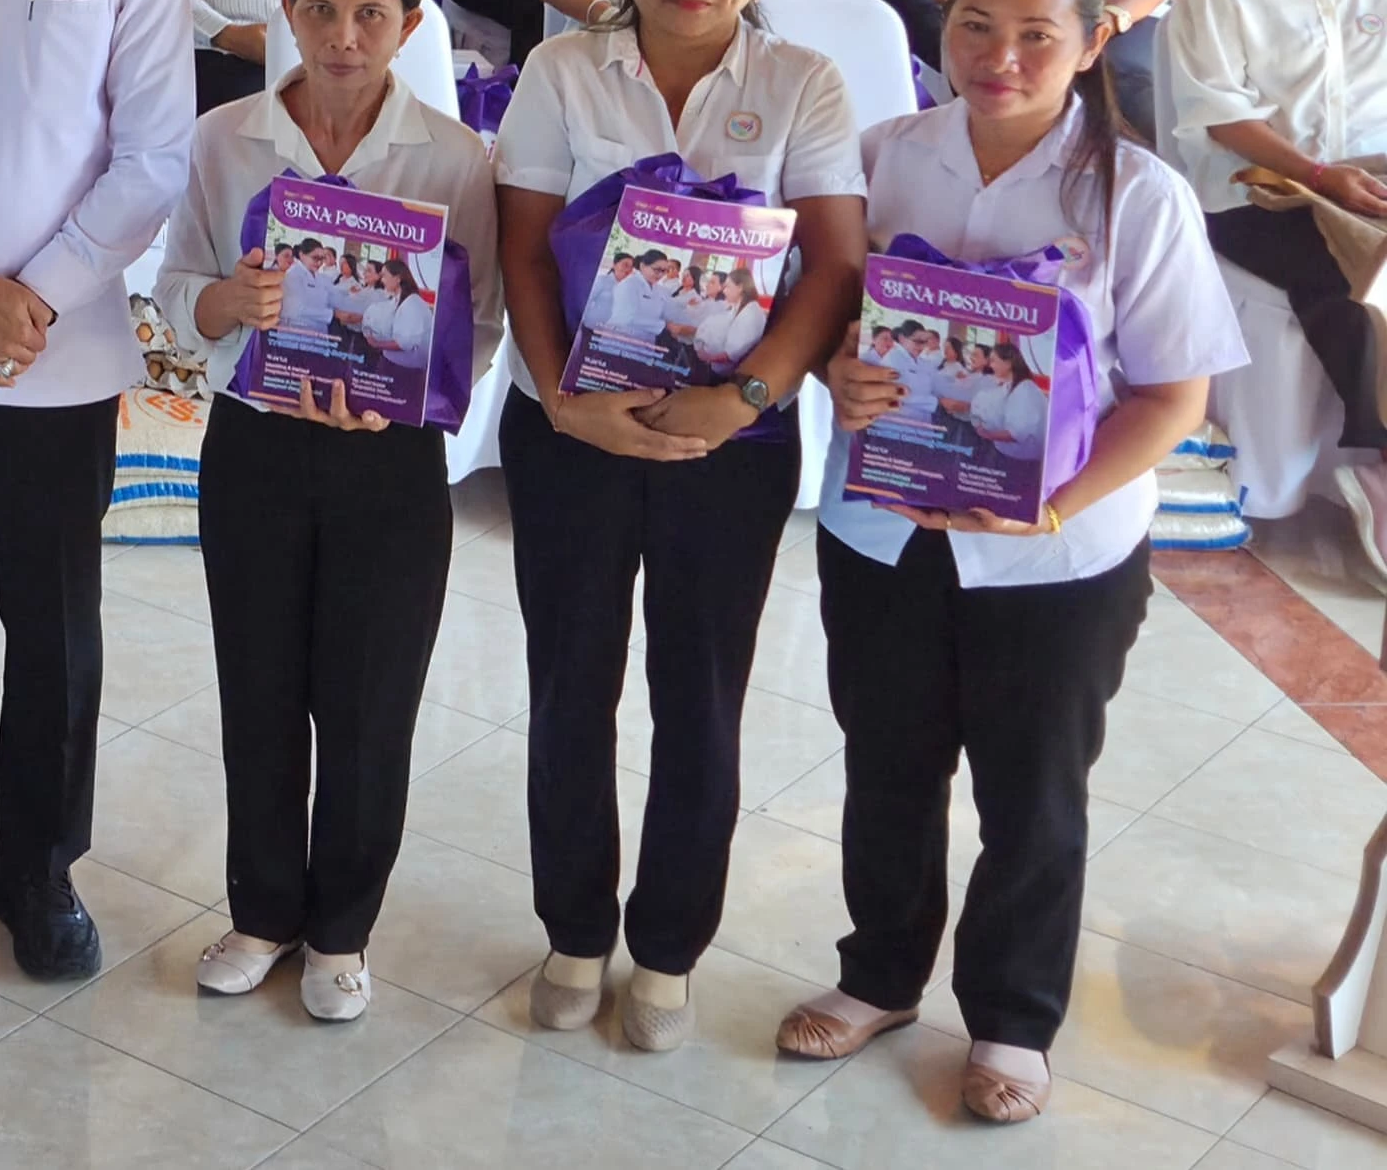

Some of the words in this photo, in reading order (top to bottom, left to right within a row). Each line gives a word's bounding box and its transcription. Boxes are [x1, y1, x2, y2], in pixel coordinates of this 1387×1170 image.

[283, 200, 333, 225] BINA
[335, 210, 425, 243] POSYANDU
[632, 210, 683, 235] BINA
[685, 222, 774, 248] POSYANDU
[881, 279, 934, 306] BINA
[938, 291, 1038, 326] POSYANDU
